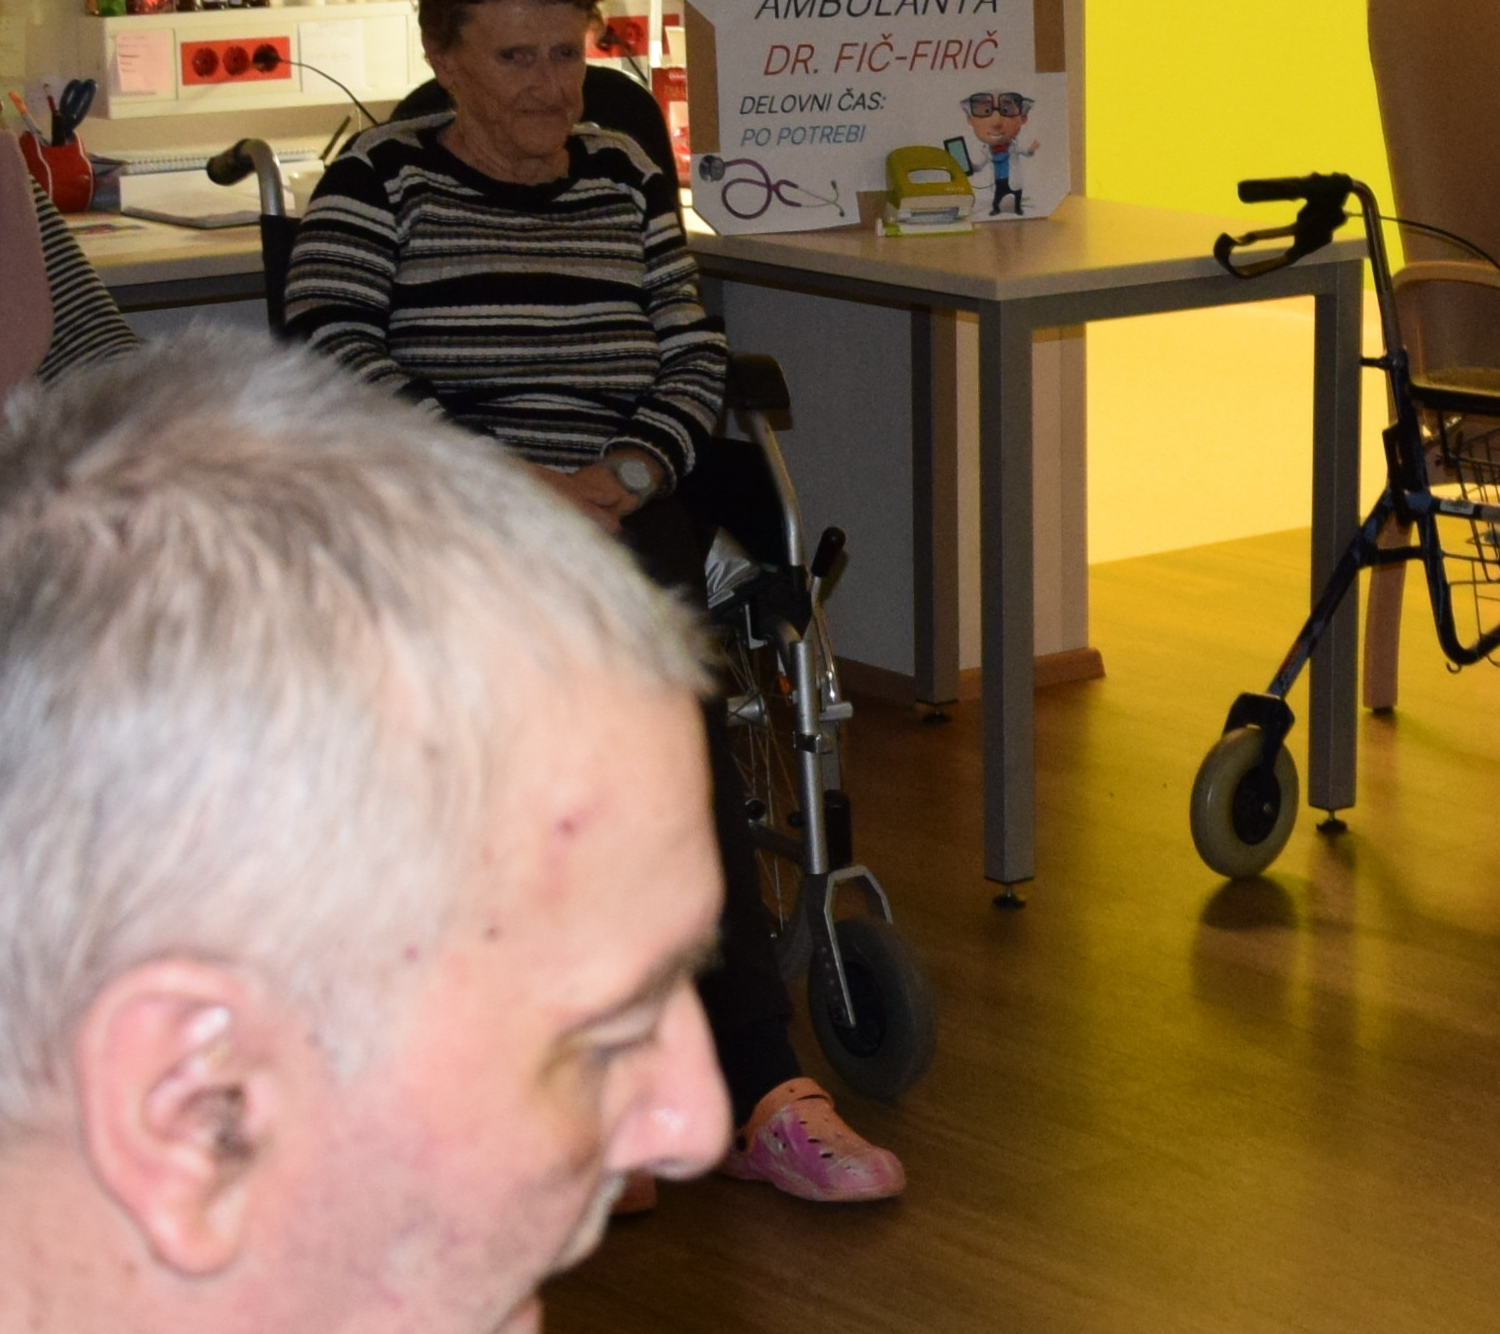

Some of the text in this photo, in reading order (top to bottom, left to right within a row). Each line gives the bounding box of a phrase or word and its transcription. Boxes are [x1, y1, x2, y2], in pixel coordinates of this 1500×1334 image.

[763, 30, 999, 76] DR. FIČ-FIRIČ
[739, 88, 887, 115] DELOVNI ČAS:
[740, 124, 867, 147] PO POTREBI
